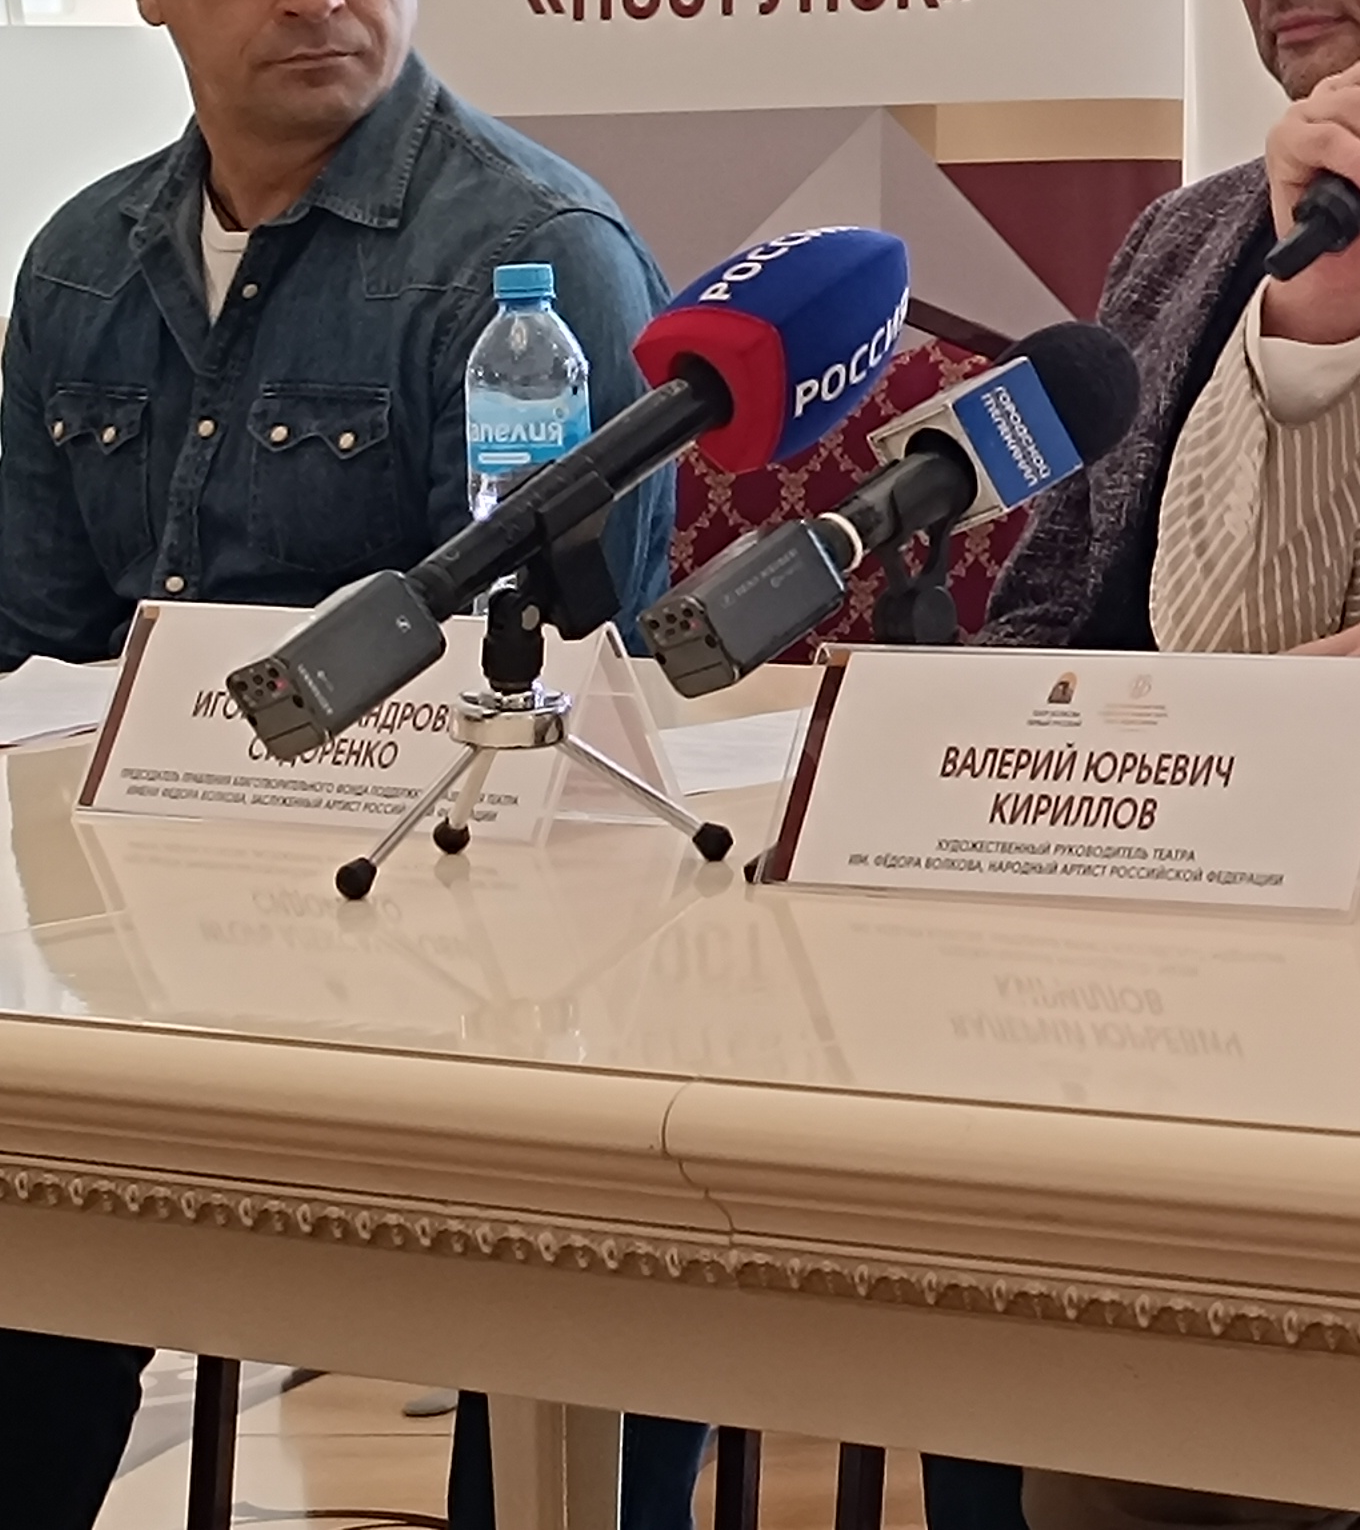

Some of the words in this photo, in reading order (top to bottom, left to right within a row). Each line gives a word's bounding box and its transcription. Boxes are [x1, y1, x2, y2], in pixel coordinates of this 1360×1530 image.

[939, 742, 1078, 784] ВАЛЕРИЙ
[1082, 751, 1235, 789] ЮРЬЕВИЧ
[323, 799, 361, 812] АРТИСТ
[988, 793, 1158, 831] КИРИЛЛОВ
[936, 838, 1051, 855] ХУДОЖЕСТВЕННЫЙ
[1053, 843, 1148, 860] РУКОВОДИТЕЛЬ
[1152, 847, 1196, 862] ТЕАТРА
[988, 860, 1057, 876] НАРОДНЫЙ
[1060, 863, 1107, 878] АРТИСТ
[1109, 864, 1203, 883] РОССИЙСКОЙ
[1206, 871, 1284, 887] ФЕДЕРАЦИИ
